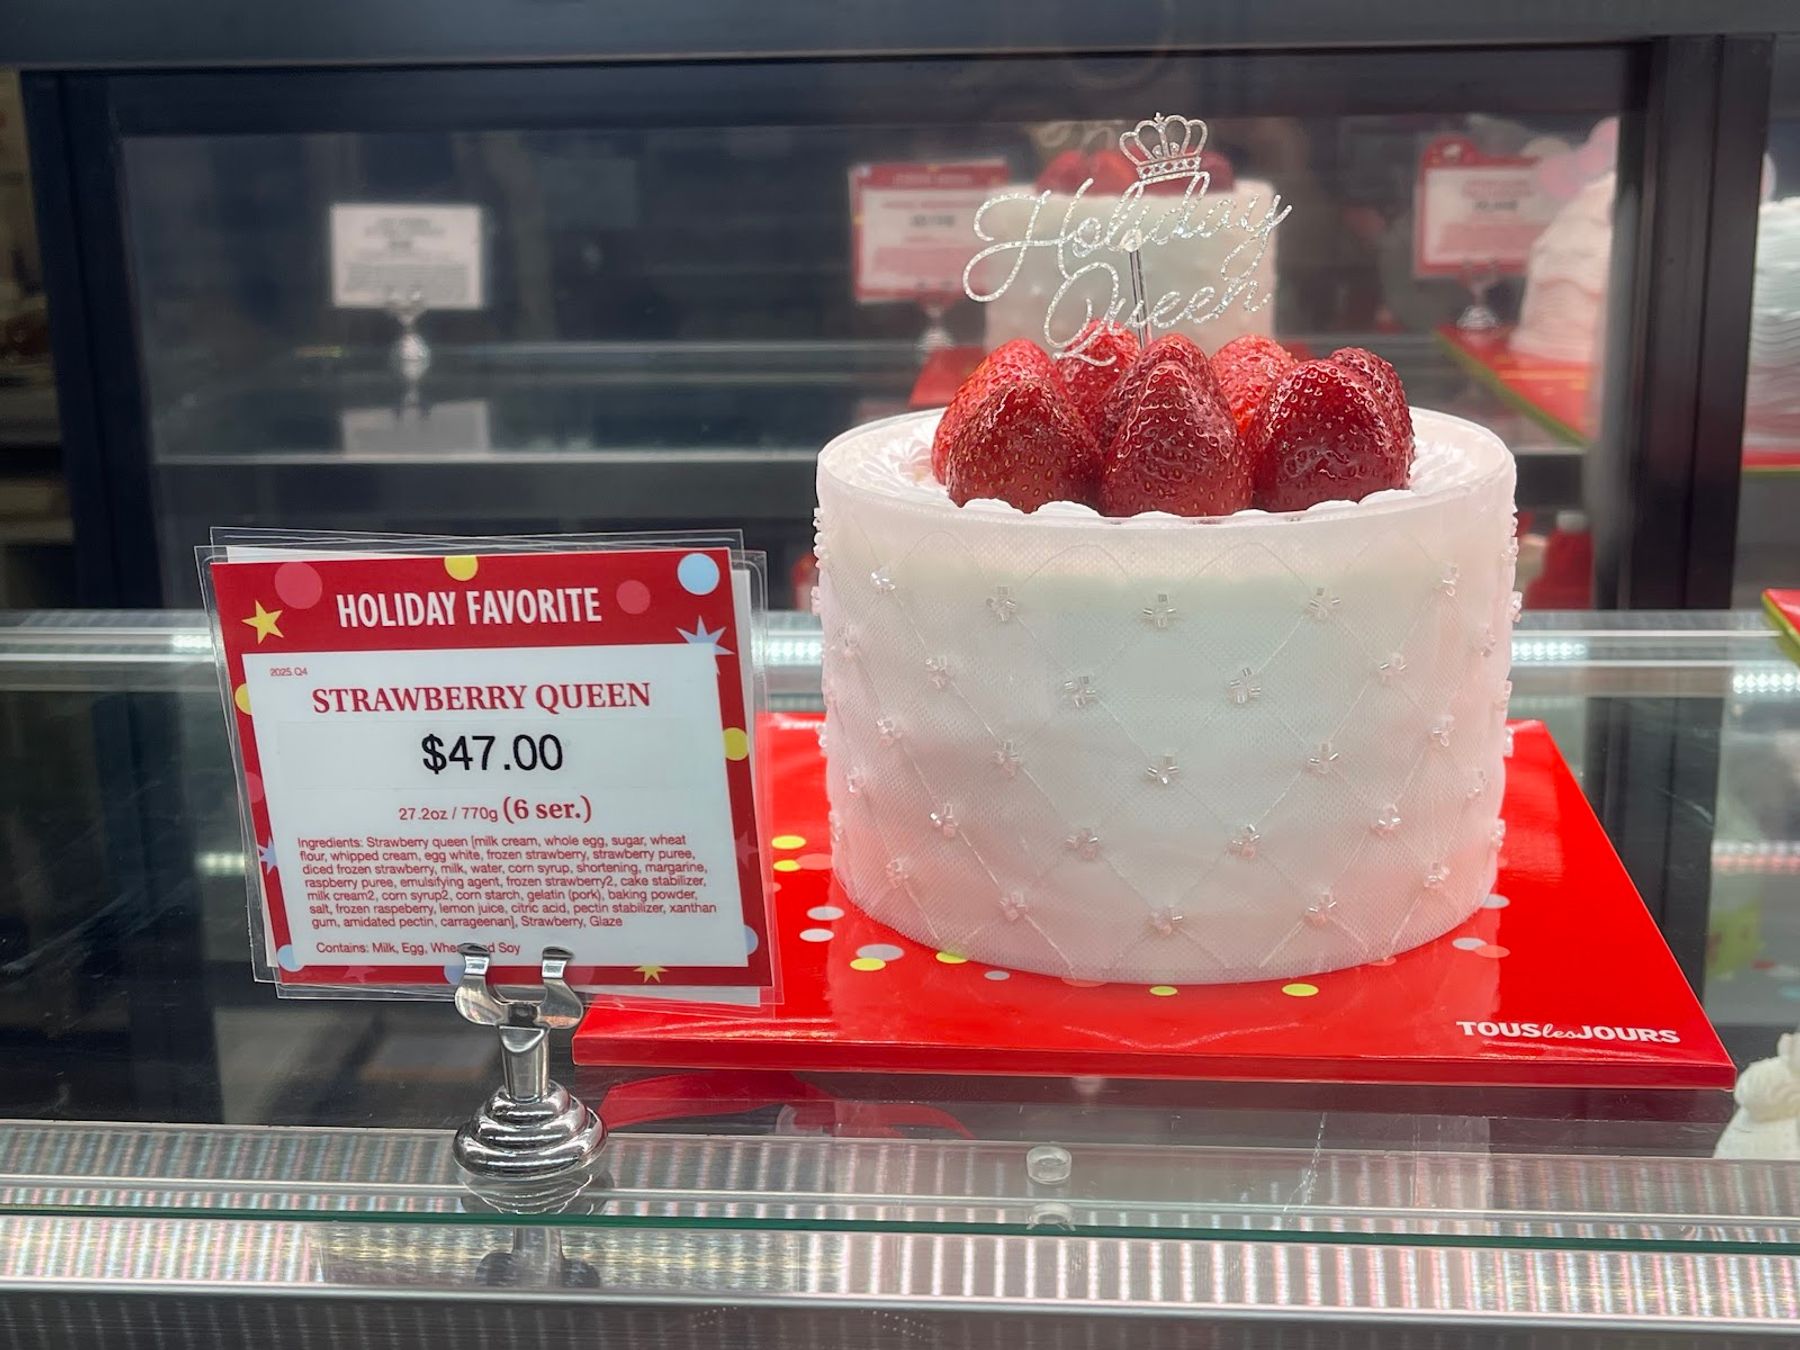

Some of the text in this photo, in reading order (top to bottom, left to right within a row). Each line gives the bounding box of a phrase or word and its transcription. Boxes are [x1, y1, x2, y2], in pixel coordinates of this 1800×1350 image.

[963, 178, 1293, 302] Holiday
[1043, 262, 1272, 366] Queen
[336, 587, 602, 628] HOLIDAY FAVORITE
[294, 666, 308, 676] Q4
[312, 682, 650, 714] STRAWBERRY QUEEN
[421, 733, 563, 775] $47.00
[399, 795, 592, 824] 27.2oz / 770g (6 ser.)
[298, 837, 363, 850] Ingredients:
[367, 837, 428, 849] Strawberry
[432, 838, 468, 849] queen
[502, 837, 541, 847] cream,
[544, 836, 579, 845] whole
[583, 837, 608, 848] egg,
[612, 836, 647, 847] sugar,
[650, 835, 686, 845] wheat
[300, 850, 696, 863] flour, whipped cream, egg white, frozen strawberry, strawberry puree,
[303, 862, 708, 875] diced frozen strawberry, milk, water, corn syrup, shortening, margarine,
[305, 877, 357, 890] raspberry
[362, 878, 396, 889] puree,
[400, 877, 464, 889] emulsifying
[468, 877, 503, 888] agent,
[506, 876, 542, 886] frozen
[545, 876, 616, 888] strawberry2,
[621, 876, 648, 886] cake
[308, 890, 697, 902] milk cream2, corn syrup2, corn starch, gelatin (pork), baking powder,
[310, 904, 332, 914] salt,
[336, 904, 370, 914] frozen
[440, 904, 474, 913] lemon
[478, 904, 508, 915] juice,
[511, 903, 538, 913] citric
[542, 903, 570, 913] acid,
[574, 903, 608, 915] pectin
[670, 903, 716, 913] xanthan
[312, 914, 623, 929] gum, amidated pectin, carrageenan], Strawberry, Glaze
[316, 942, 369, 953] Contains:
[372, 943, 399, 954] Milk,
[402, 943, 428, 955] Egg,
[431, 942, 462, 954] Whe
[498, 942, 520, 956] Soy
